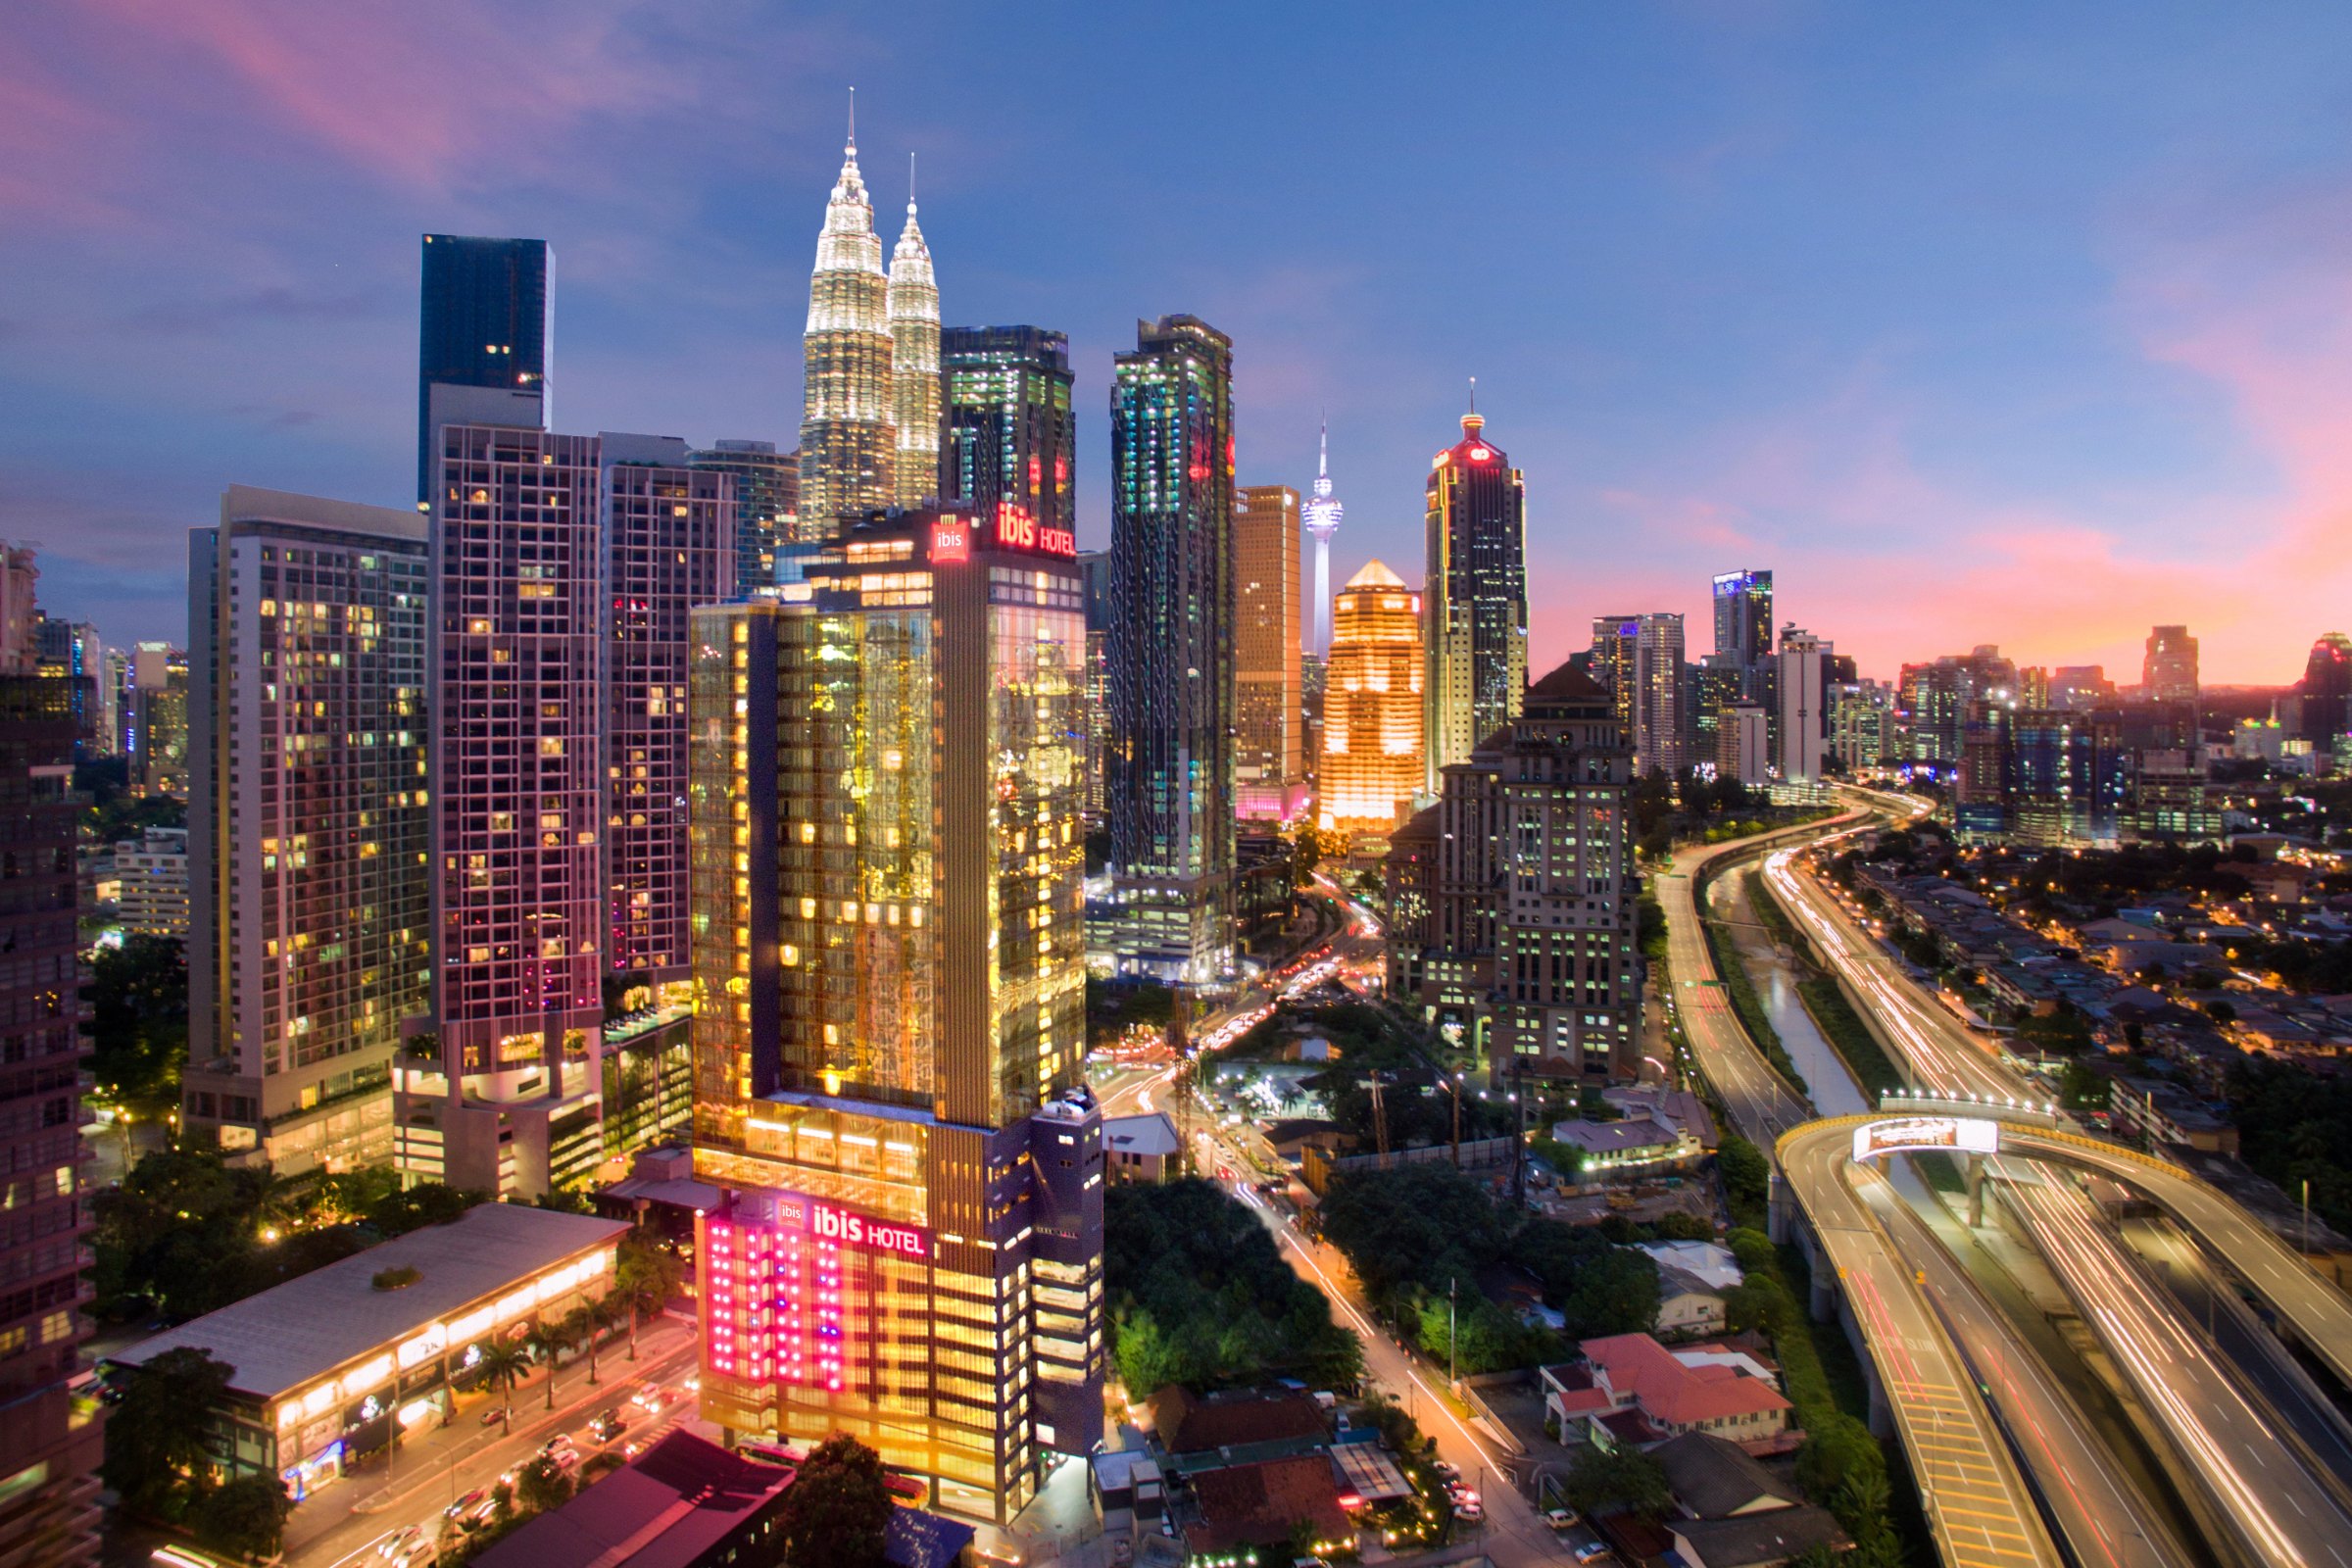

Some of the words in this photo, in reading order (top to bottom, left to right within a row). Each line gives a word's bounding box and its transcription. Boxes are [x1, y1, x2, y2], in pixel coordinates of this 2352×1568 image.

[938, 530, 962, 548] ibis
[999, 502, 1034, 546] ibis
[1040, 527, 1077, 557] HOTEL
[782, 1204, 801, 1219] ibis
[813, 1205, 862, 1242] ibis
[867, 1224, 924, 1254] HOTEL
